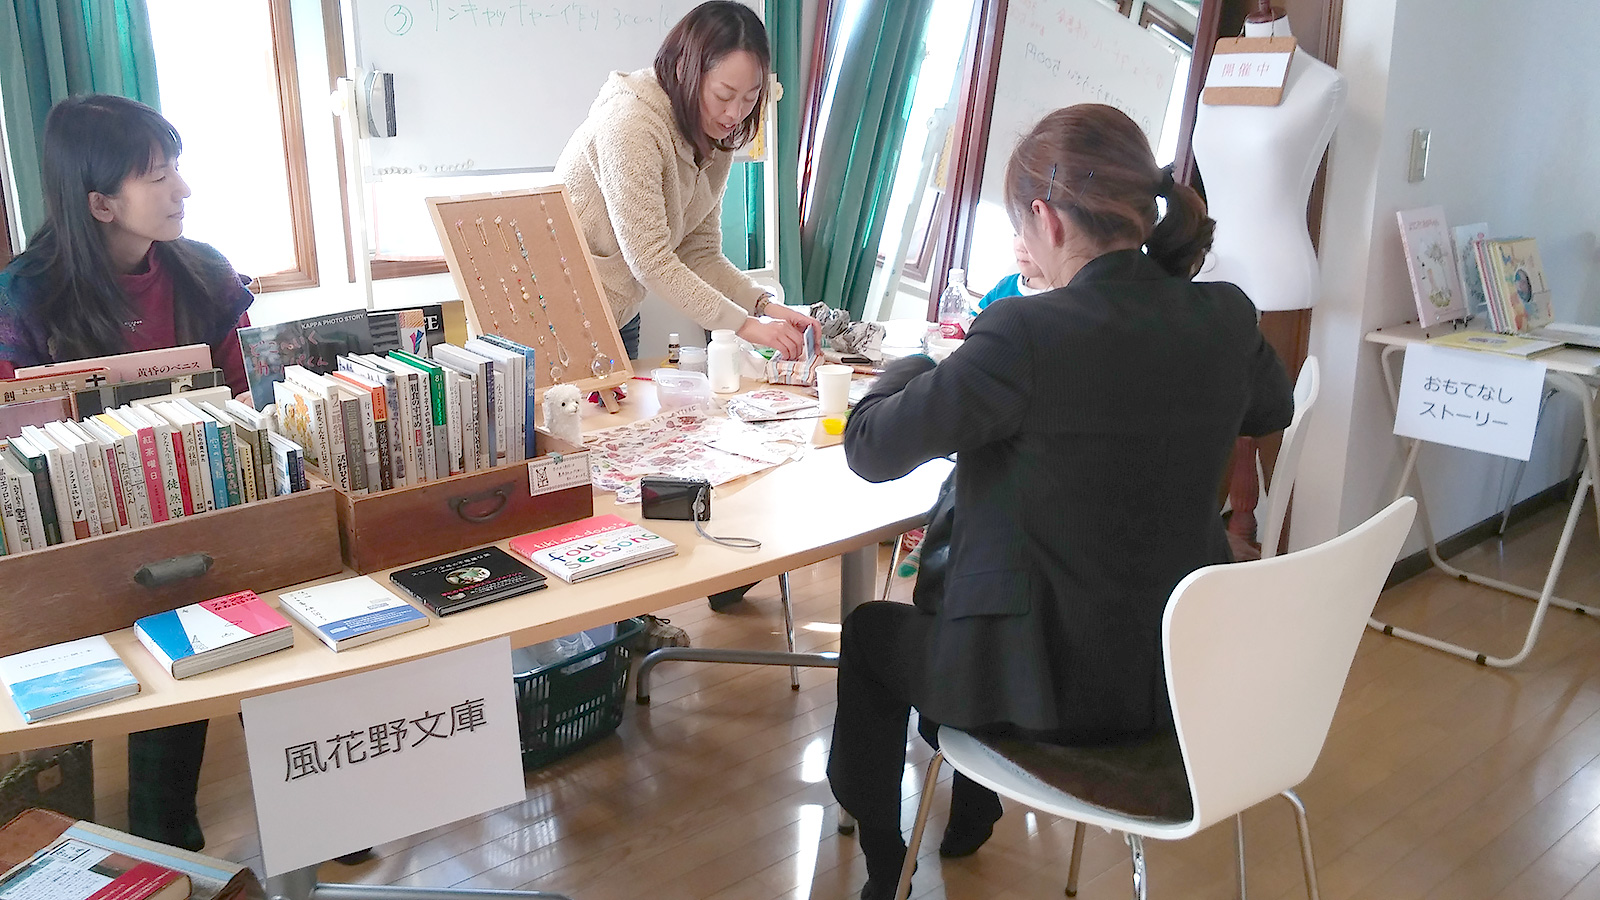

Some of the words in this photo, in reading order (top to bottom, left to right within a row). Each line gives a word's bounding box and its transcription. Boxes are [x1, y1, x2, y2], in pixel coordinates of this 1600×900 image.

[1221, 62, 1270, 77] 開催中
[301, 320, 323, 330] KAPPA
[323, 316, 343, 327] PHOTO
[343, 312, 364, 323] STORY
[137, 361, 200, 378] 黄昏のベニス
[1423, 375, 1513, 404] おもてなし
[410, 383, 422, 428] 和食のすすめ
[1419, 401, 1508, 427] ストーリー
[142, 435, 158, 480] 紅茶曜日
[187, 431, 197, 467] メモの技術
[584, 523, 628, 536] dodo's
[565, 530, 661, 570] seasons
[284, 697, 487, 783] 風花野文庫
